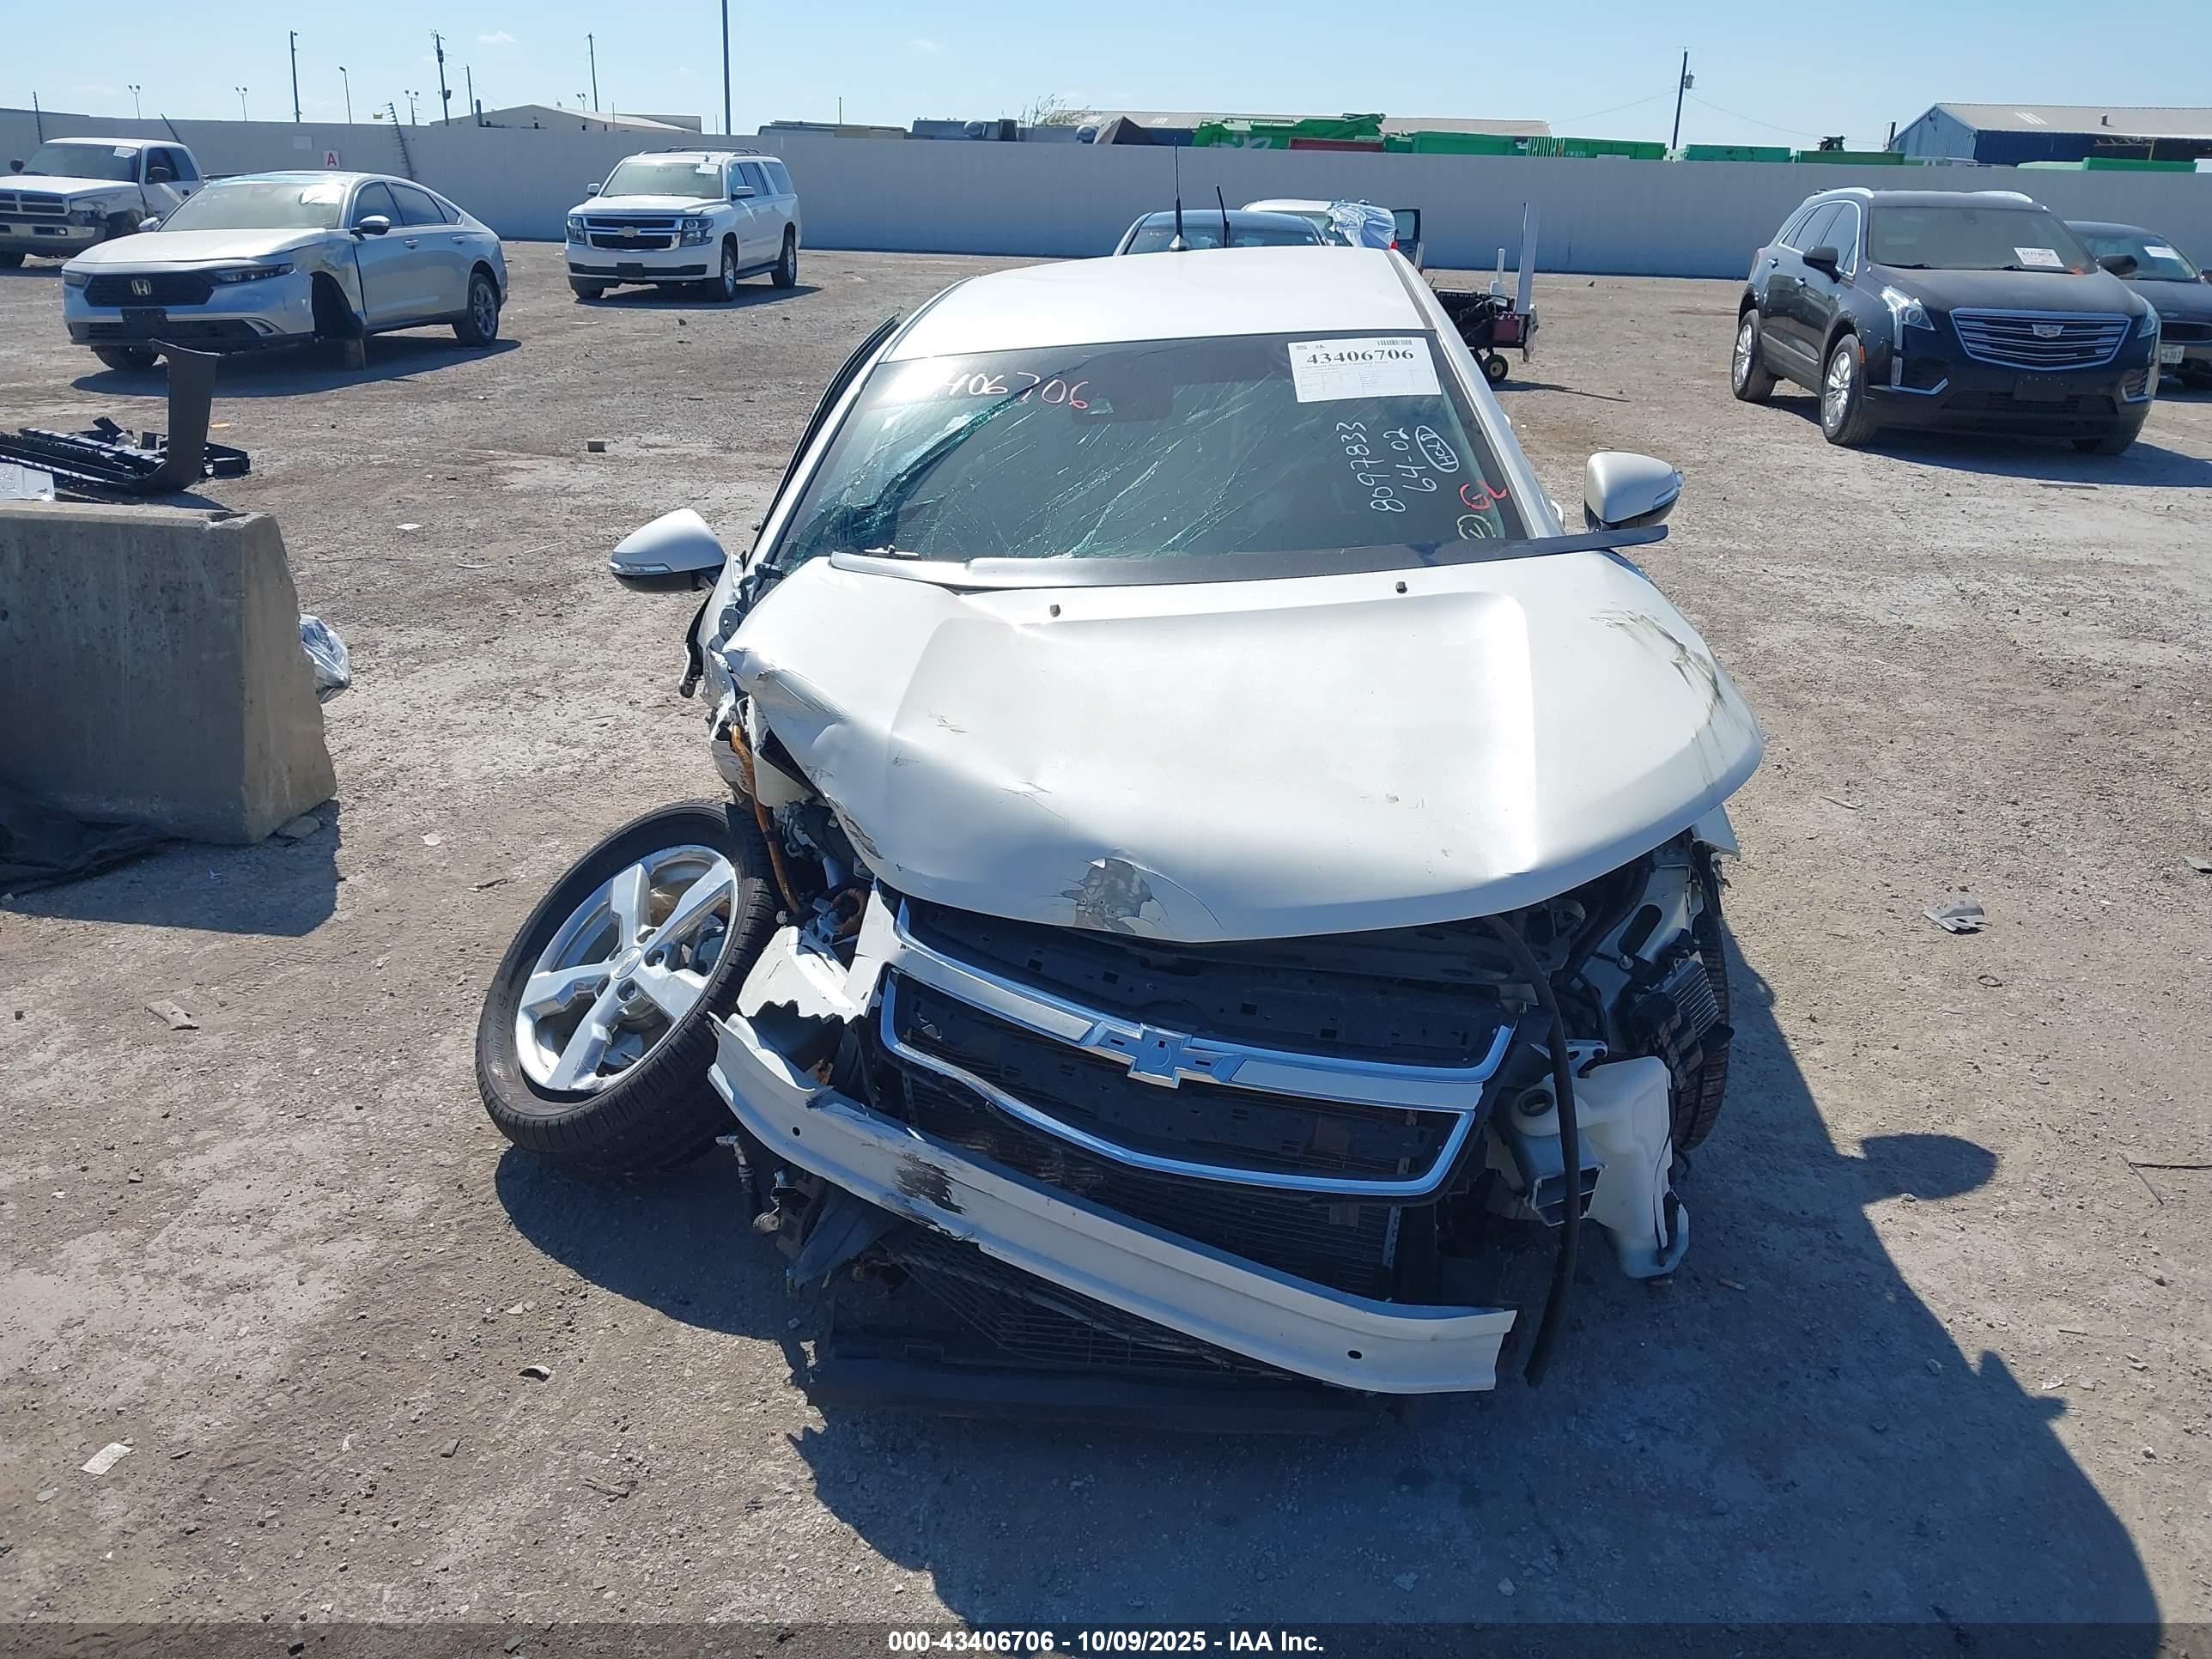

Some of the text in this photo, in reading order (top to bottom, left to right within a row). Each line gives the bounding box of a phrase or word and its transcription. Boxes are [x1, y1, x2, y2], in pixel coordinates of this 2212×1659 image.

[327, 152, 337, 167] A
[1306, 349, 1414, 364] 43406706
[1336, 421, 1407, 513] 8097833
[1382, 428, 1437, 492] 64-02
